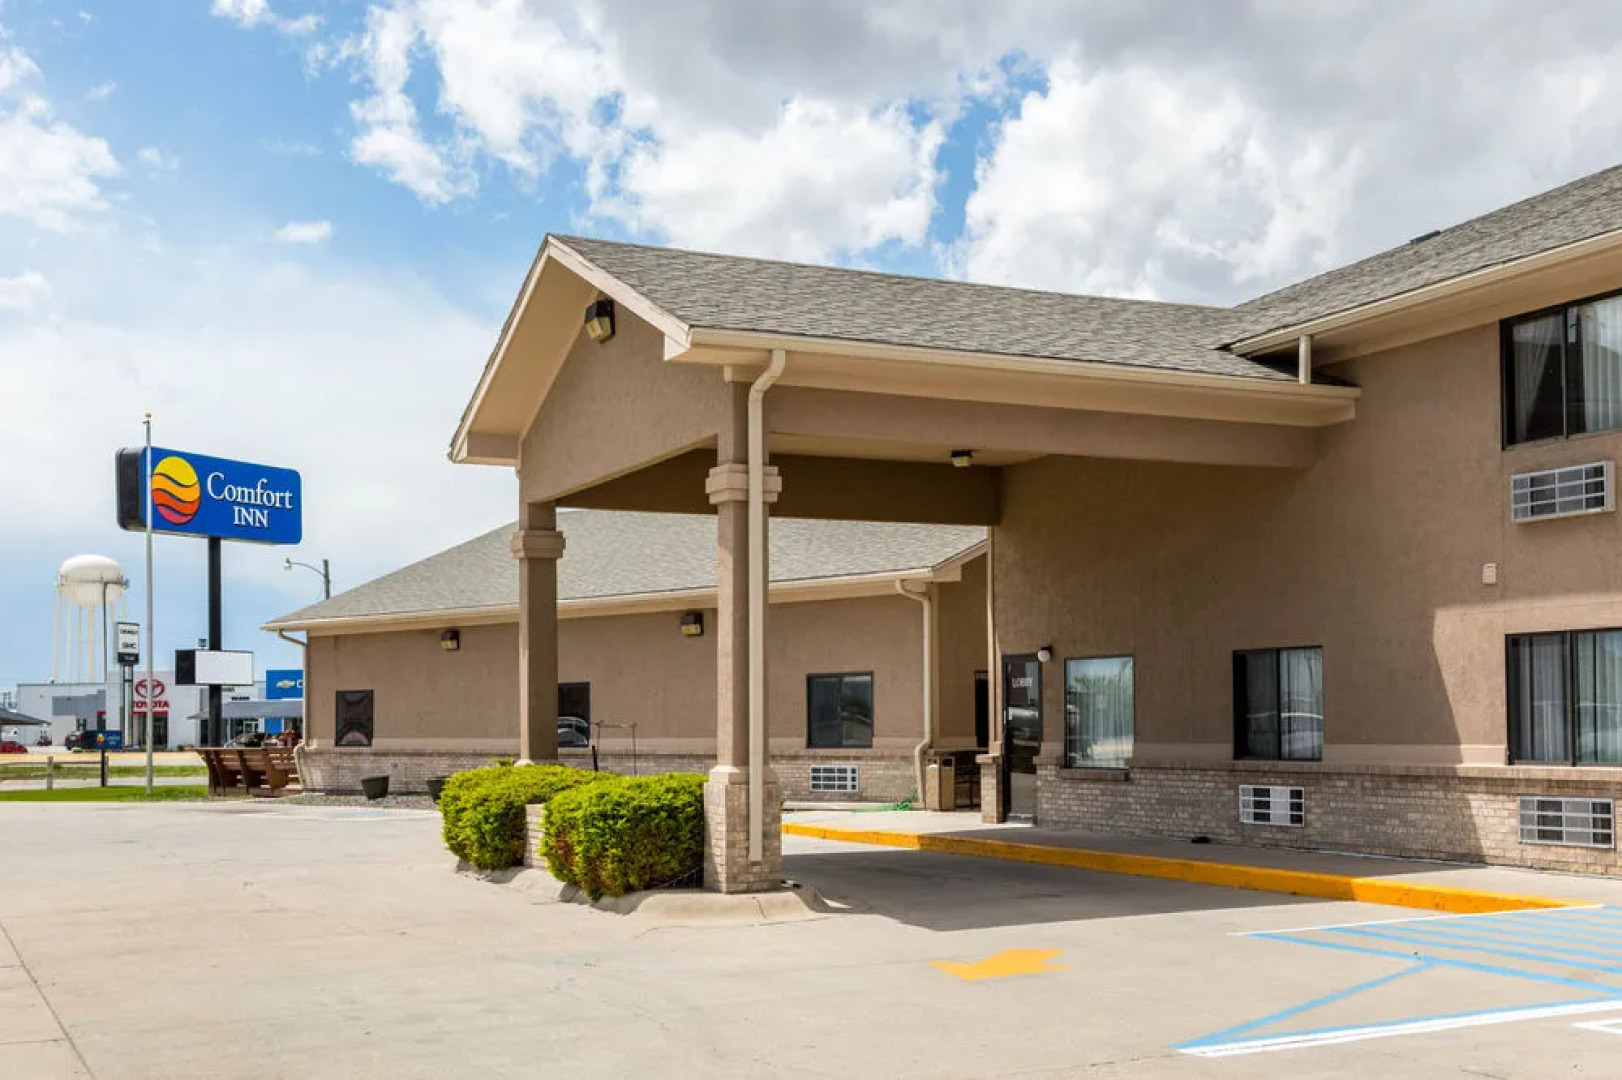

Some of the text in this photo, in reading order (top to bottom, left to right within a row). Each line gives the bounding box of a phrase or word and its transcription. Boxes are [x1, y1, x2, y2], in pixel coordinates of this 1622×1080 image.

[207, 471, 293, 508] Comfort
[233, 505, 269, 528] INN
[1011, 677, 1033, 688] LOBBY
